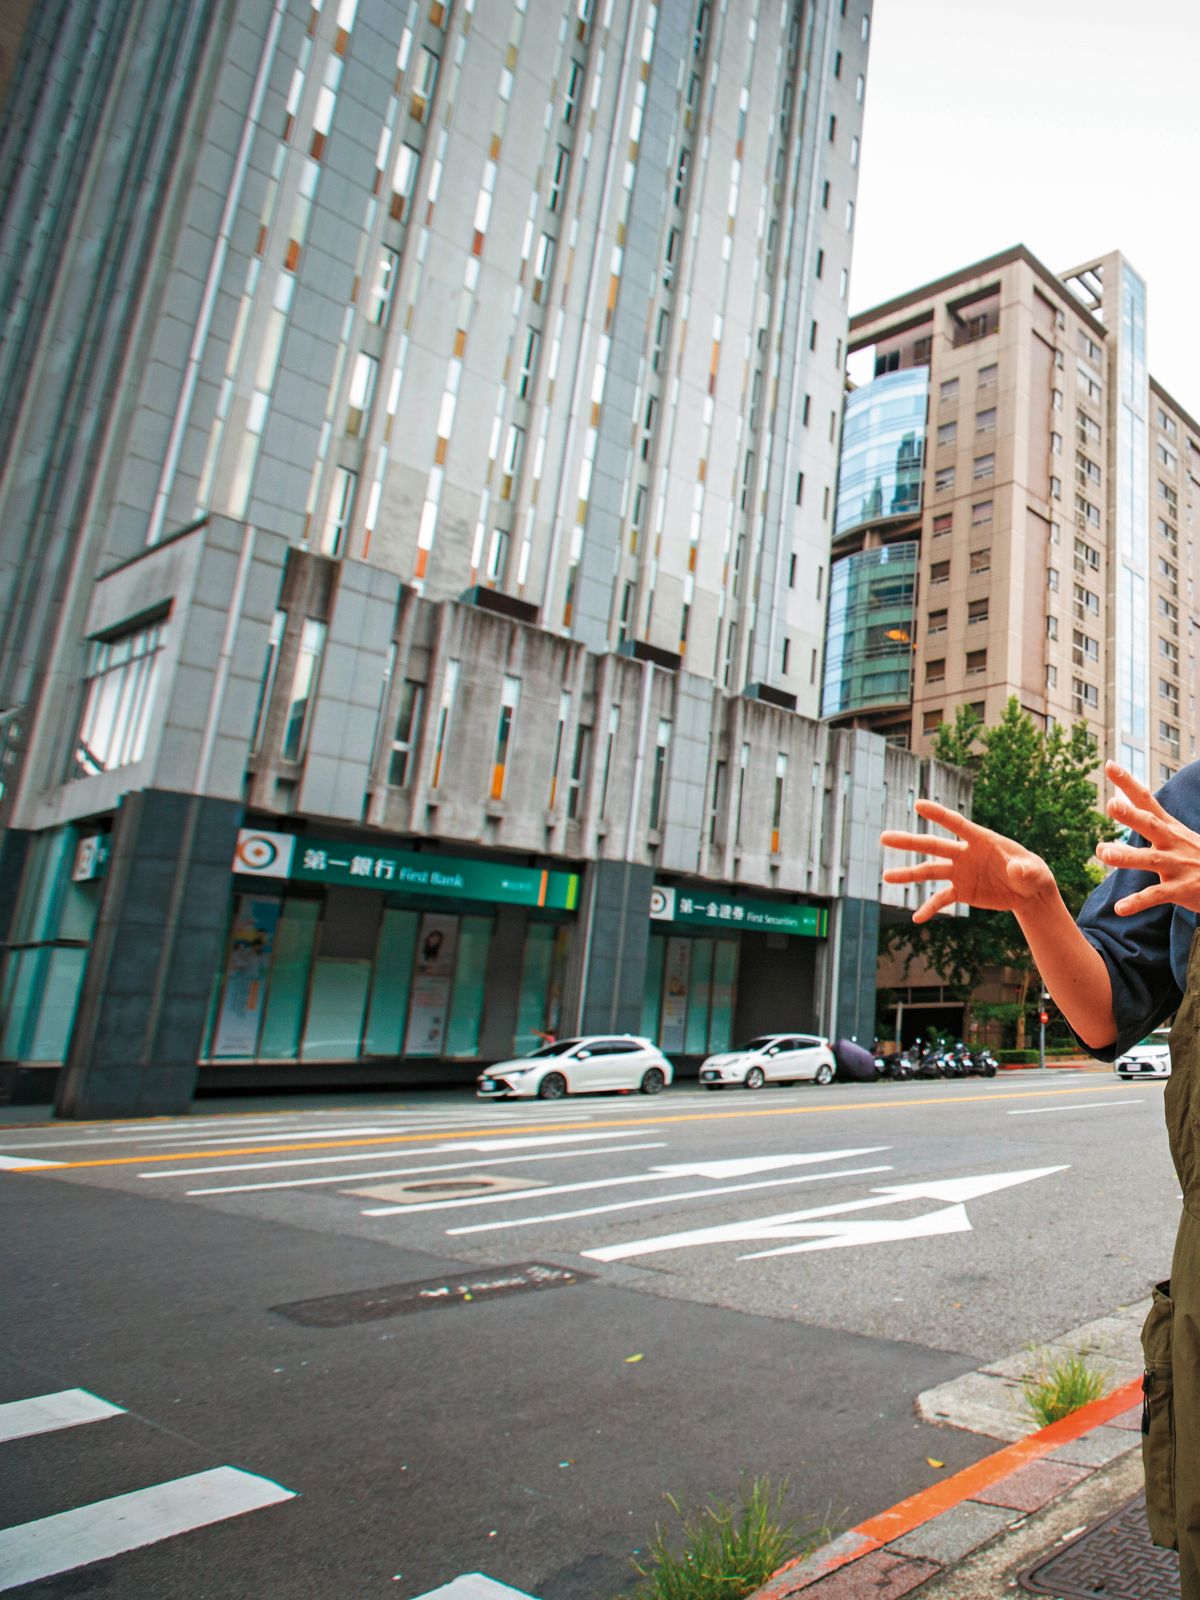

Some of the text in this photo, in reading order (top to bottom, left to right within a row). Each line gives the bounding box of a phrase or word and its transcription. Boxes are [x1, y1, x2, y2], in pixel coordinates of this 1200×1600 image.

[302, 848, 397, 880] 第一銀行
[399, 867, 464, 889] First Bank
[679, 898, 745, 921] 第一金證券
[747, 911, 763, 924] First
